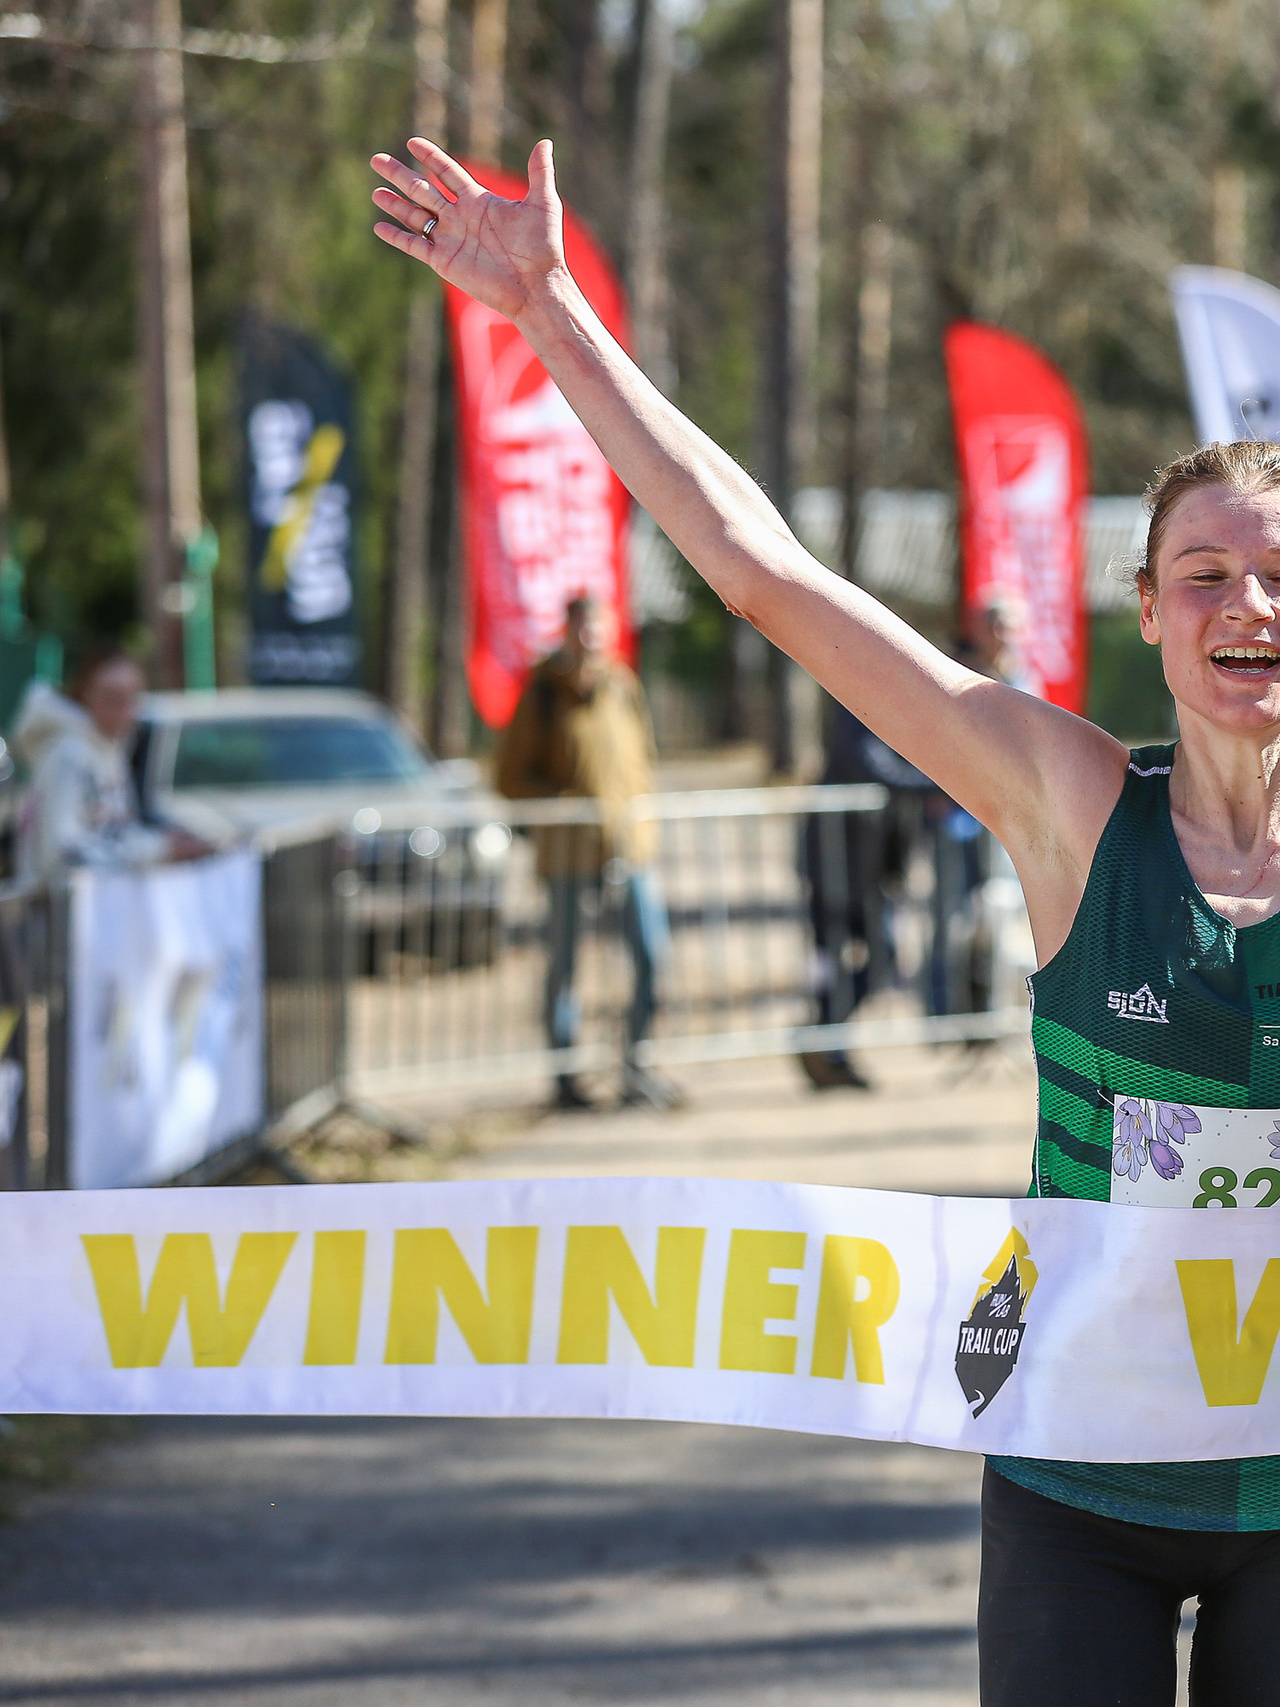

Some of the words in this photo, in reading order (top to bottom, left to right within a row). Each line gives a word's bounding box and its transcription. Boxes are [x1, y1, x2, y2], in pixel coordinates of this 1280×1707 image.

[80, 1224, 901, 1386] WINNER
[959, 1327, 993, 1354] TRAIL
[993, 1328, 1020, 1355] CUP
